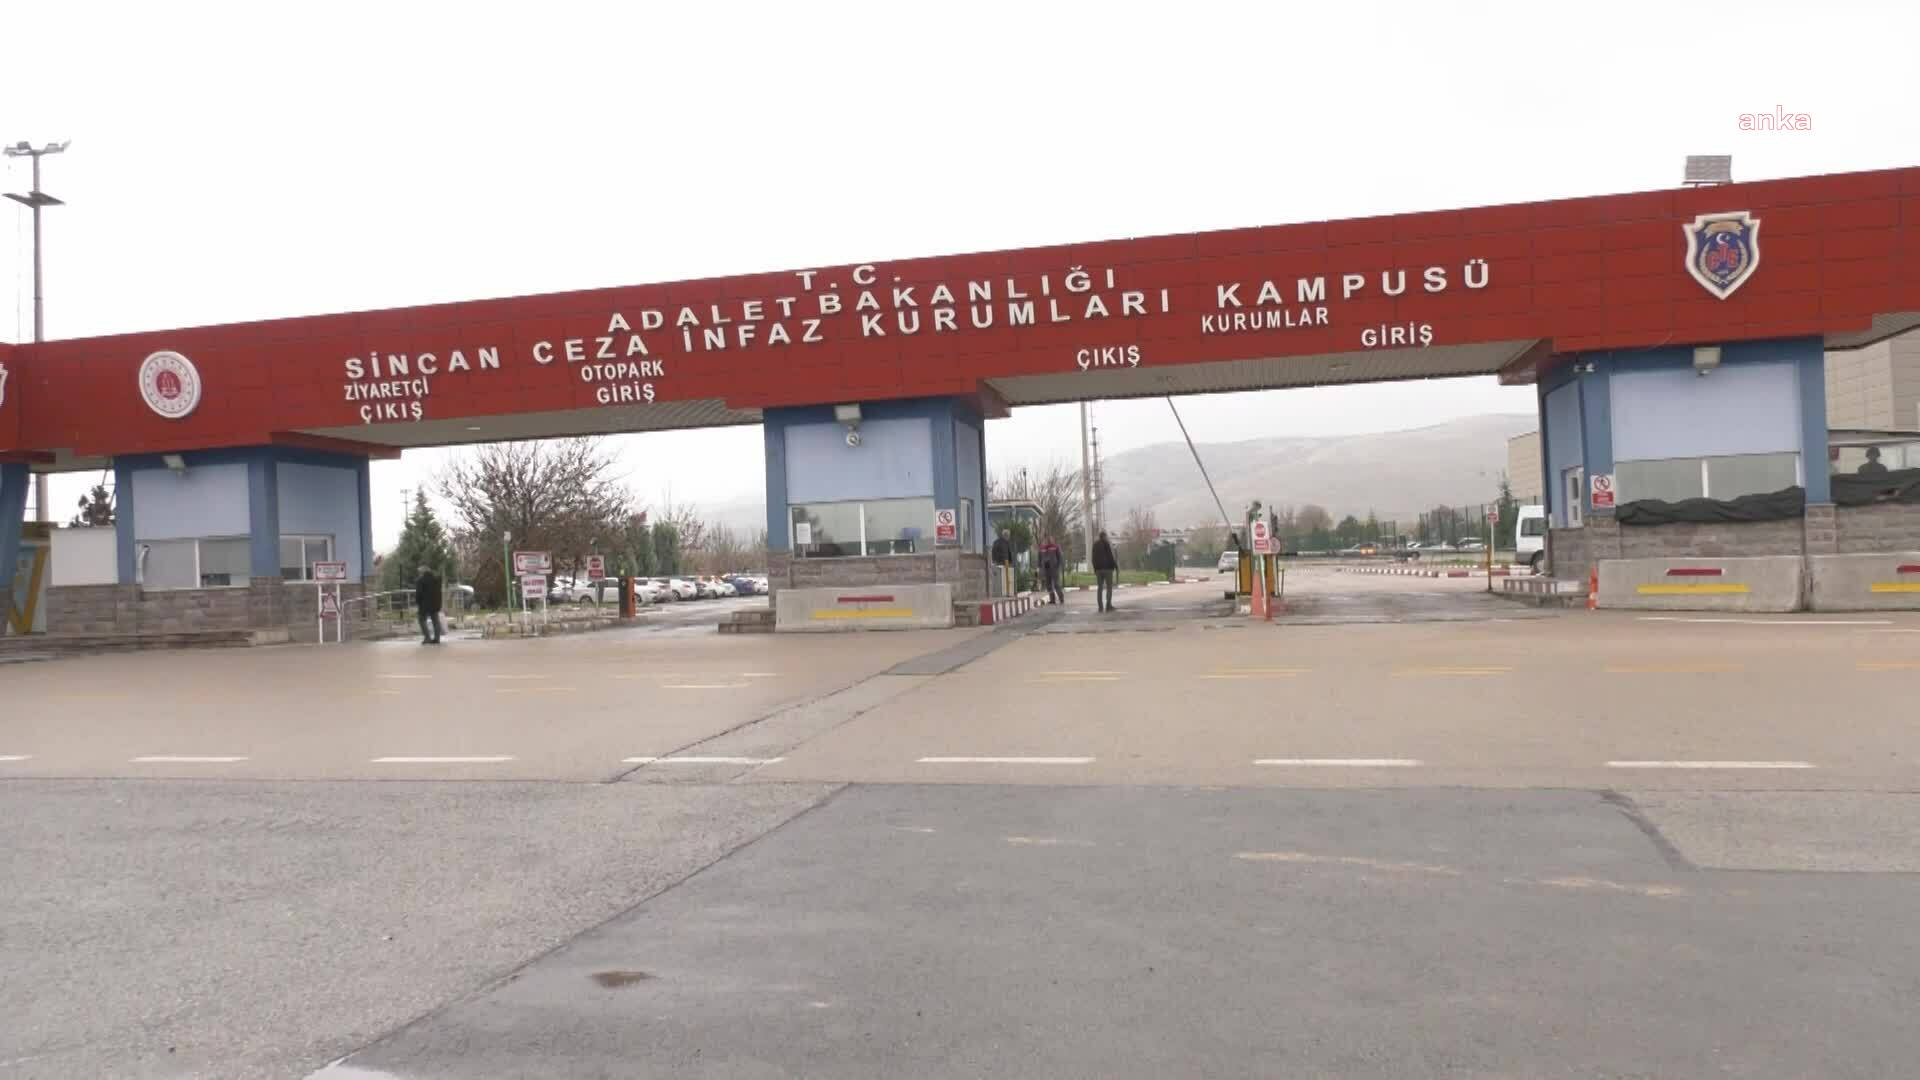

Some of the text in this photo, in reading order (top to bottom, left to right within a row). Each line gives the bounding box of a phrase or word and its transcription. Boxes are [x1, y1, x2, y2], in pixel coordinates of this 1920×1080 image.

[607, 265, 1115, 333] ADALET BAKANLIĞI
[344, 258, 1490, 379] SİNCAN CEZA İNFAZ KURUMLARI KAMPUSÜ
[1201, 306, 1329, 333] KURUMLAR
[1361, 321, 1434, 348] GİRİŞ
[580, 359, 665, 382] OTOPARK
[1076, 344, 1141, 371] ÇIKIŞ
[344, 376, 430, 401] ZİYARETÇİ
[596, 382, 656, 404] GİRİŞ
[360, 401, 424, 425] ÇIKIŞ
